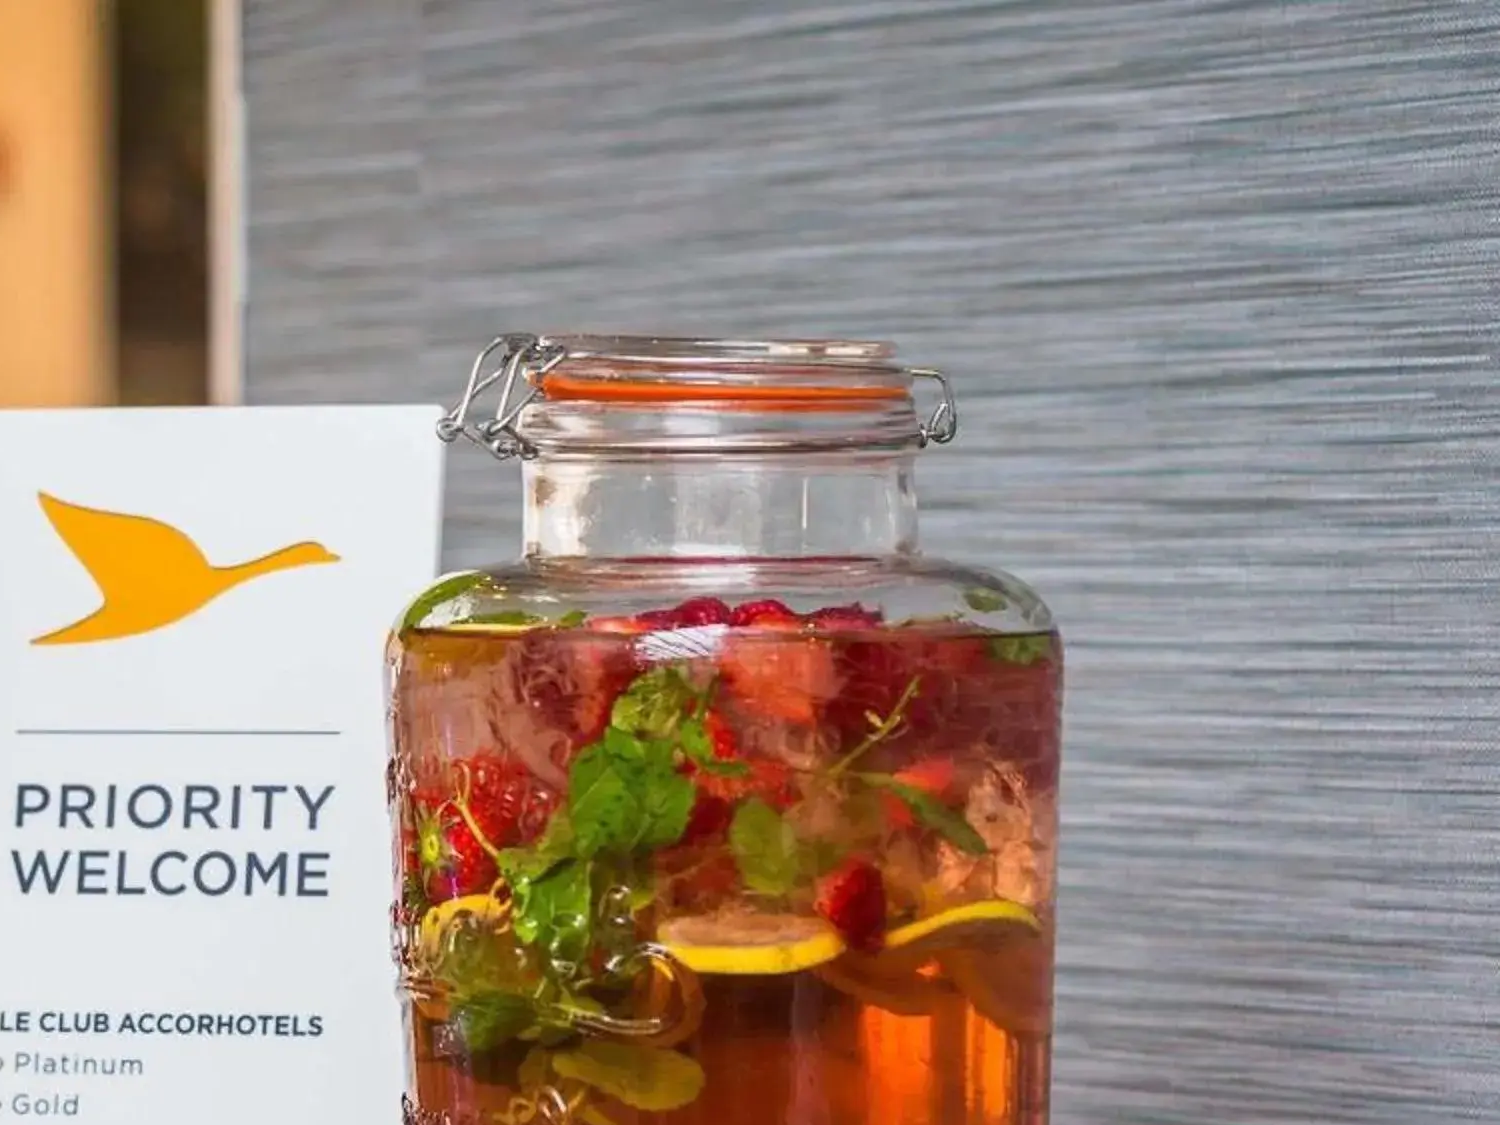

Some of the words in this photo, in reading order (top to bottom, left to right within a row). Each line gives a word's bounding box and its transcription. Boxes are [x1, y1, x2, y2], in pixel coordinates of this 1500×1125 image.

[14, 783, 336, 831] PRIORITY
[10, 849, 331, 898] WELCOME
[0, 1010, 31, 1033] LE
[38, 1010, 111, 1034] CLUB
[116, 1012, 324, 1038] ACCORHOTELS
[14, 1051, 144, 1076] Platinum
[11, 1093, 79, 1117] Gold
